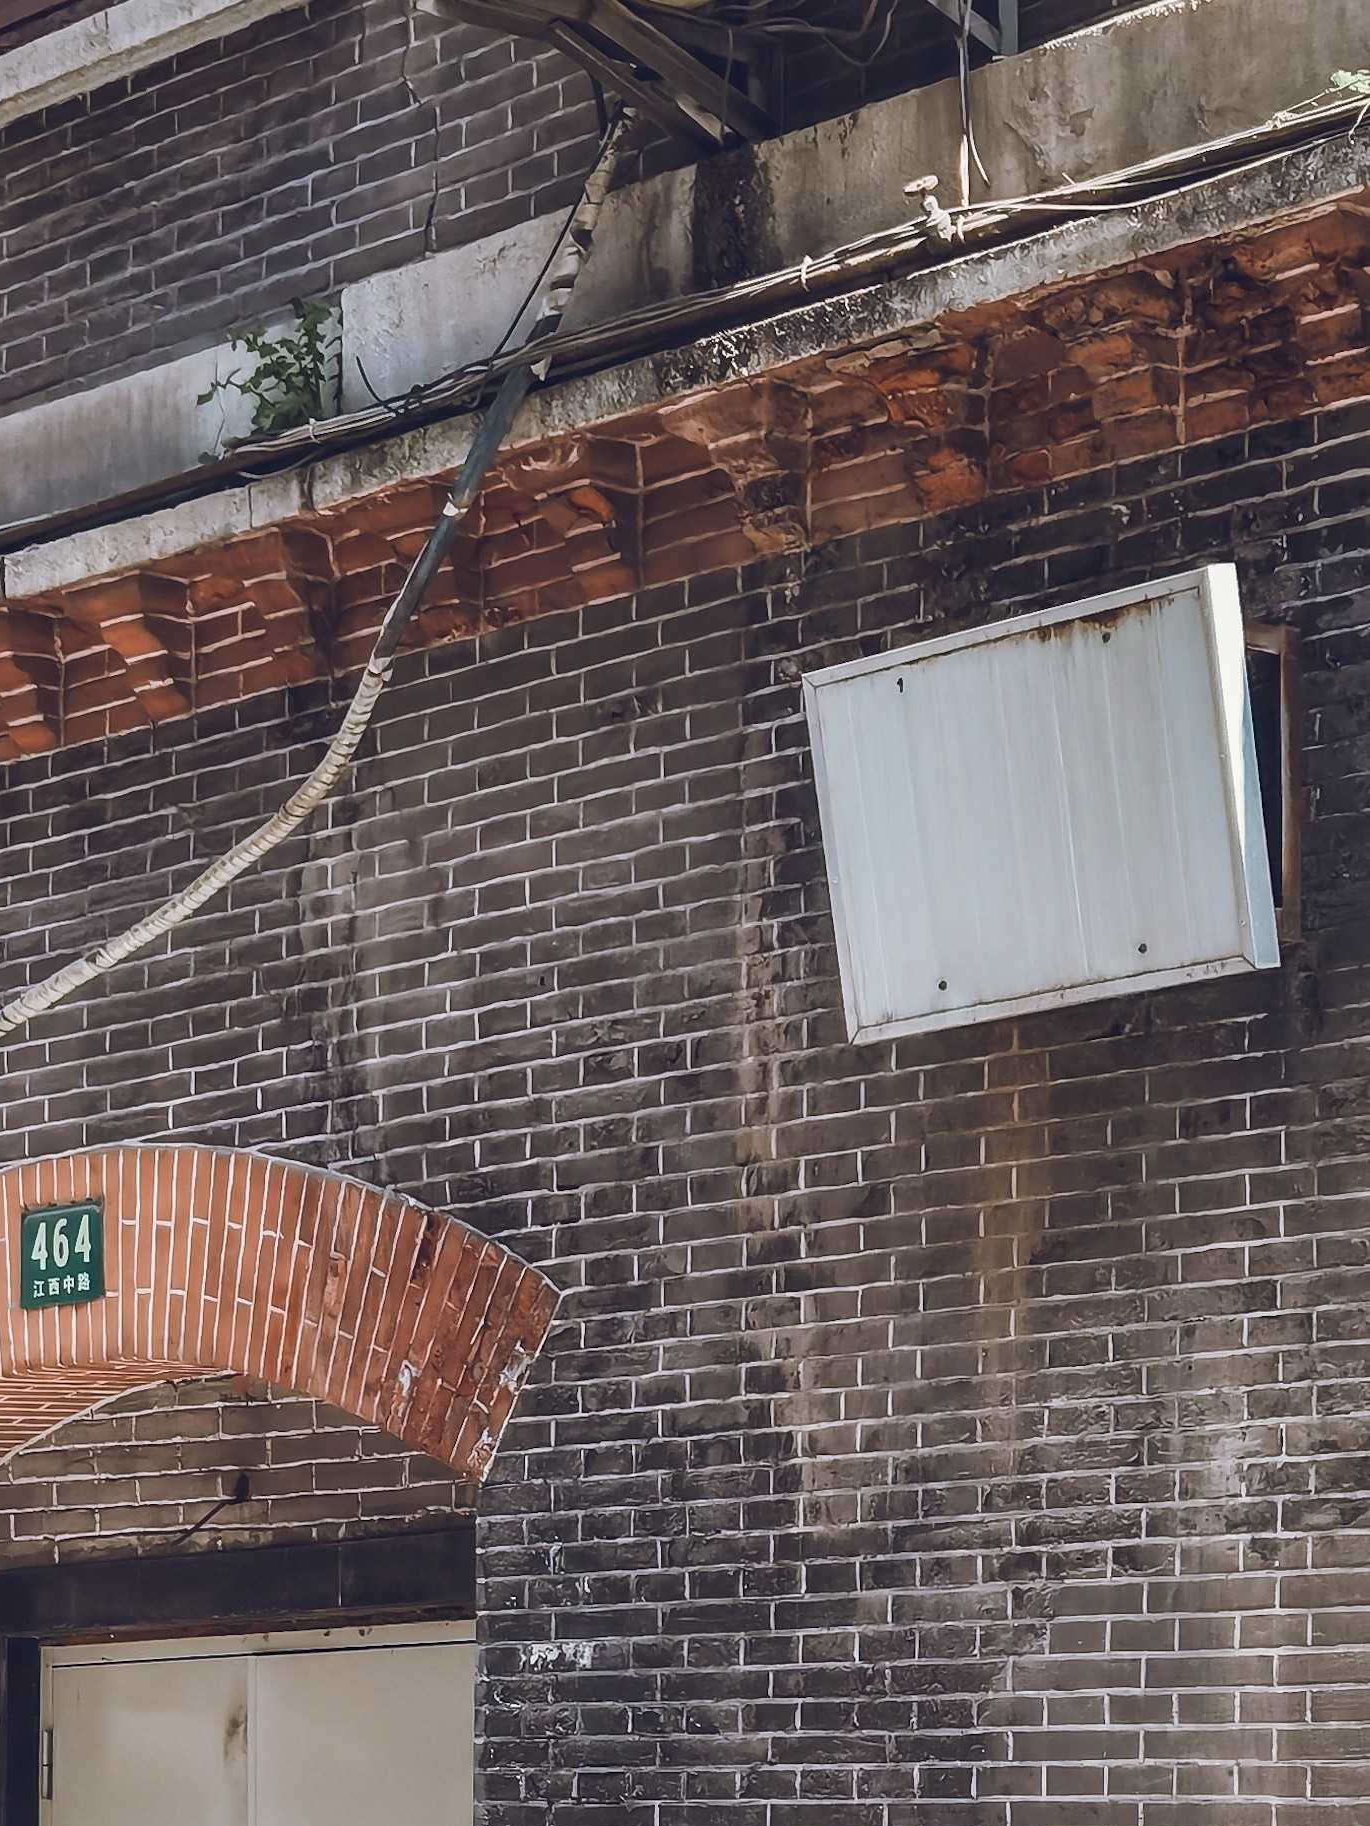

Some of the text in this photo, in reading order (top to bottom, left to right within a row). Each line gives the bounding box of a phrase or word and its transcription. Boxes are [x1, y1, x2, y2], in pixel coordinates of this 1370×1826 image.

[30, 1214, 92, 1270] 464
[33, 1272, 91, 1298] 江西中路
